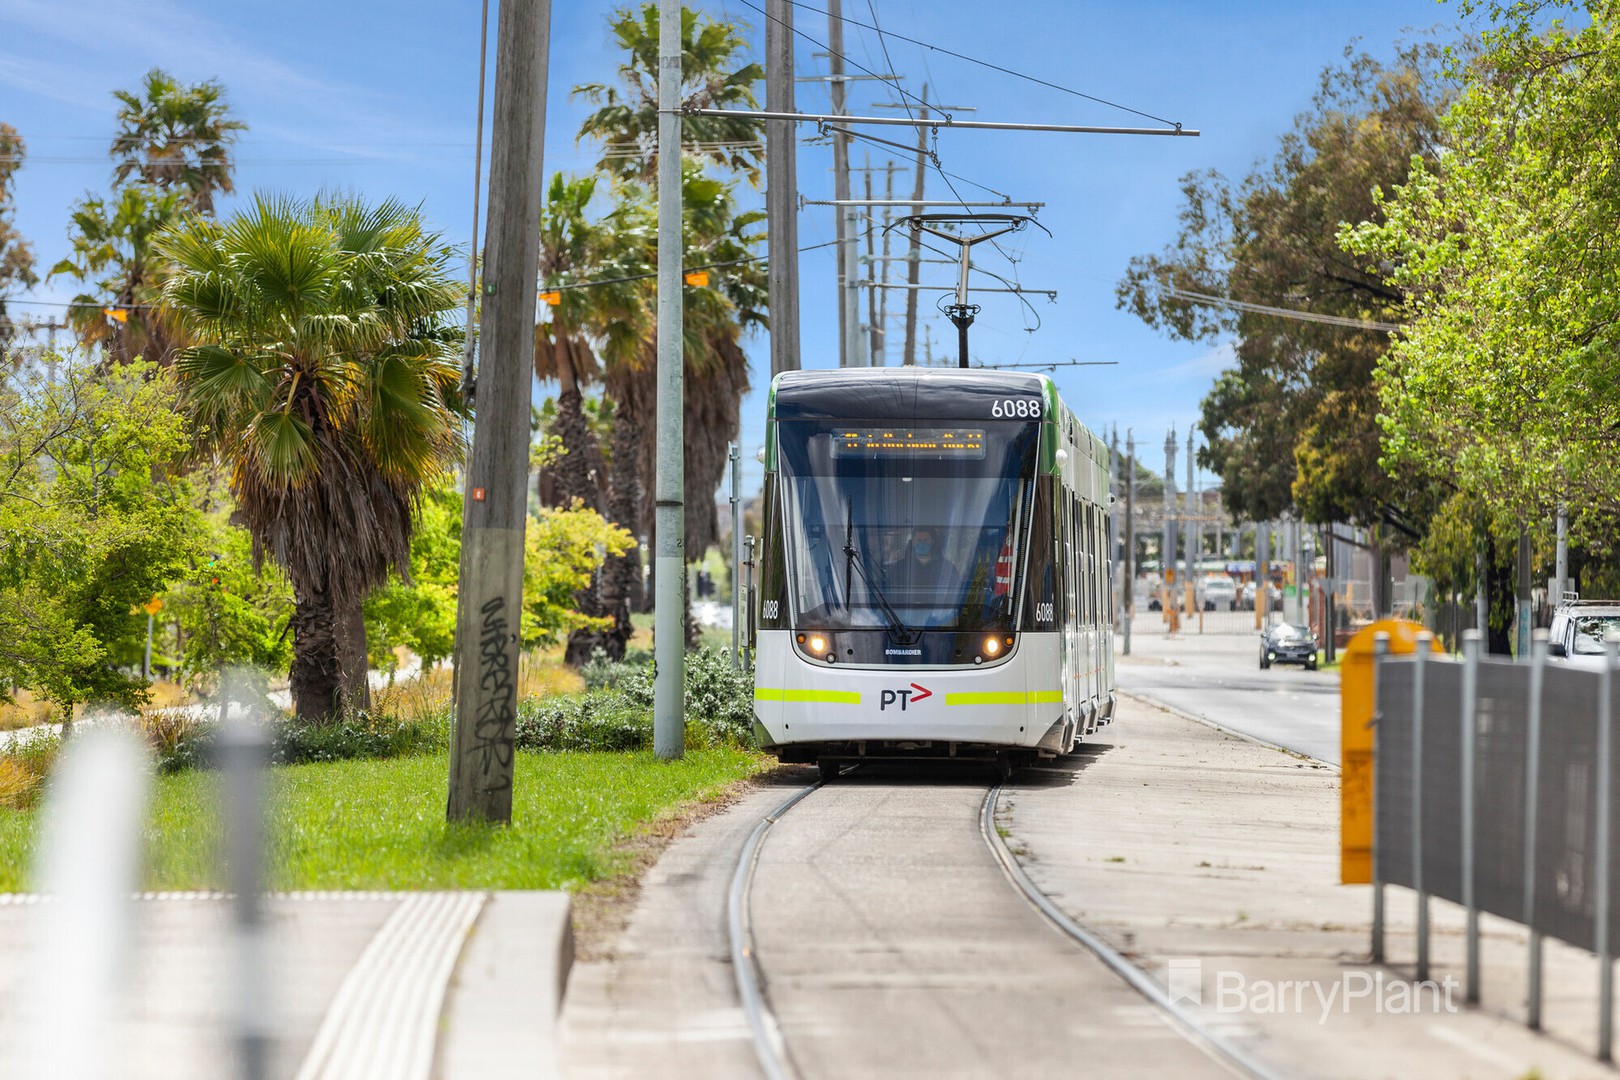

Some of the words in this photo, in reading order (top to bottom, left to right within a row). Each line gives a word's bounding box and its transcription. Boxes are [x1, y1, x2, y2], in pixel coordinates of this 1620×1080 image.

[991, 400, 1041, 418] 6088
[763, 600, 779, 619] 6088
[1036, 603, 1053, 622] 6088
